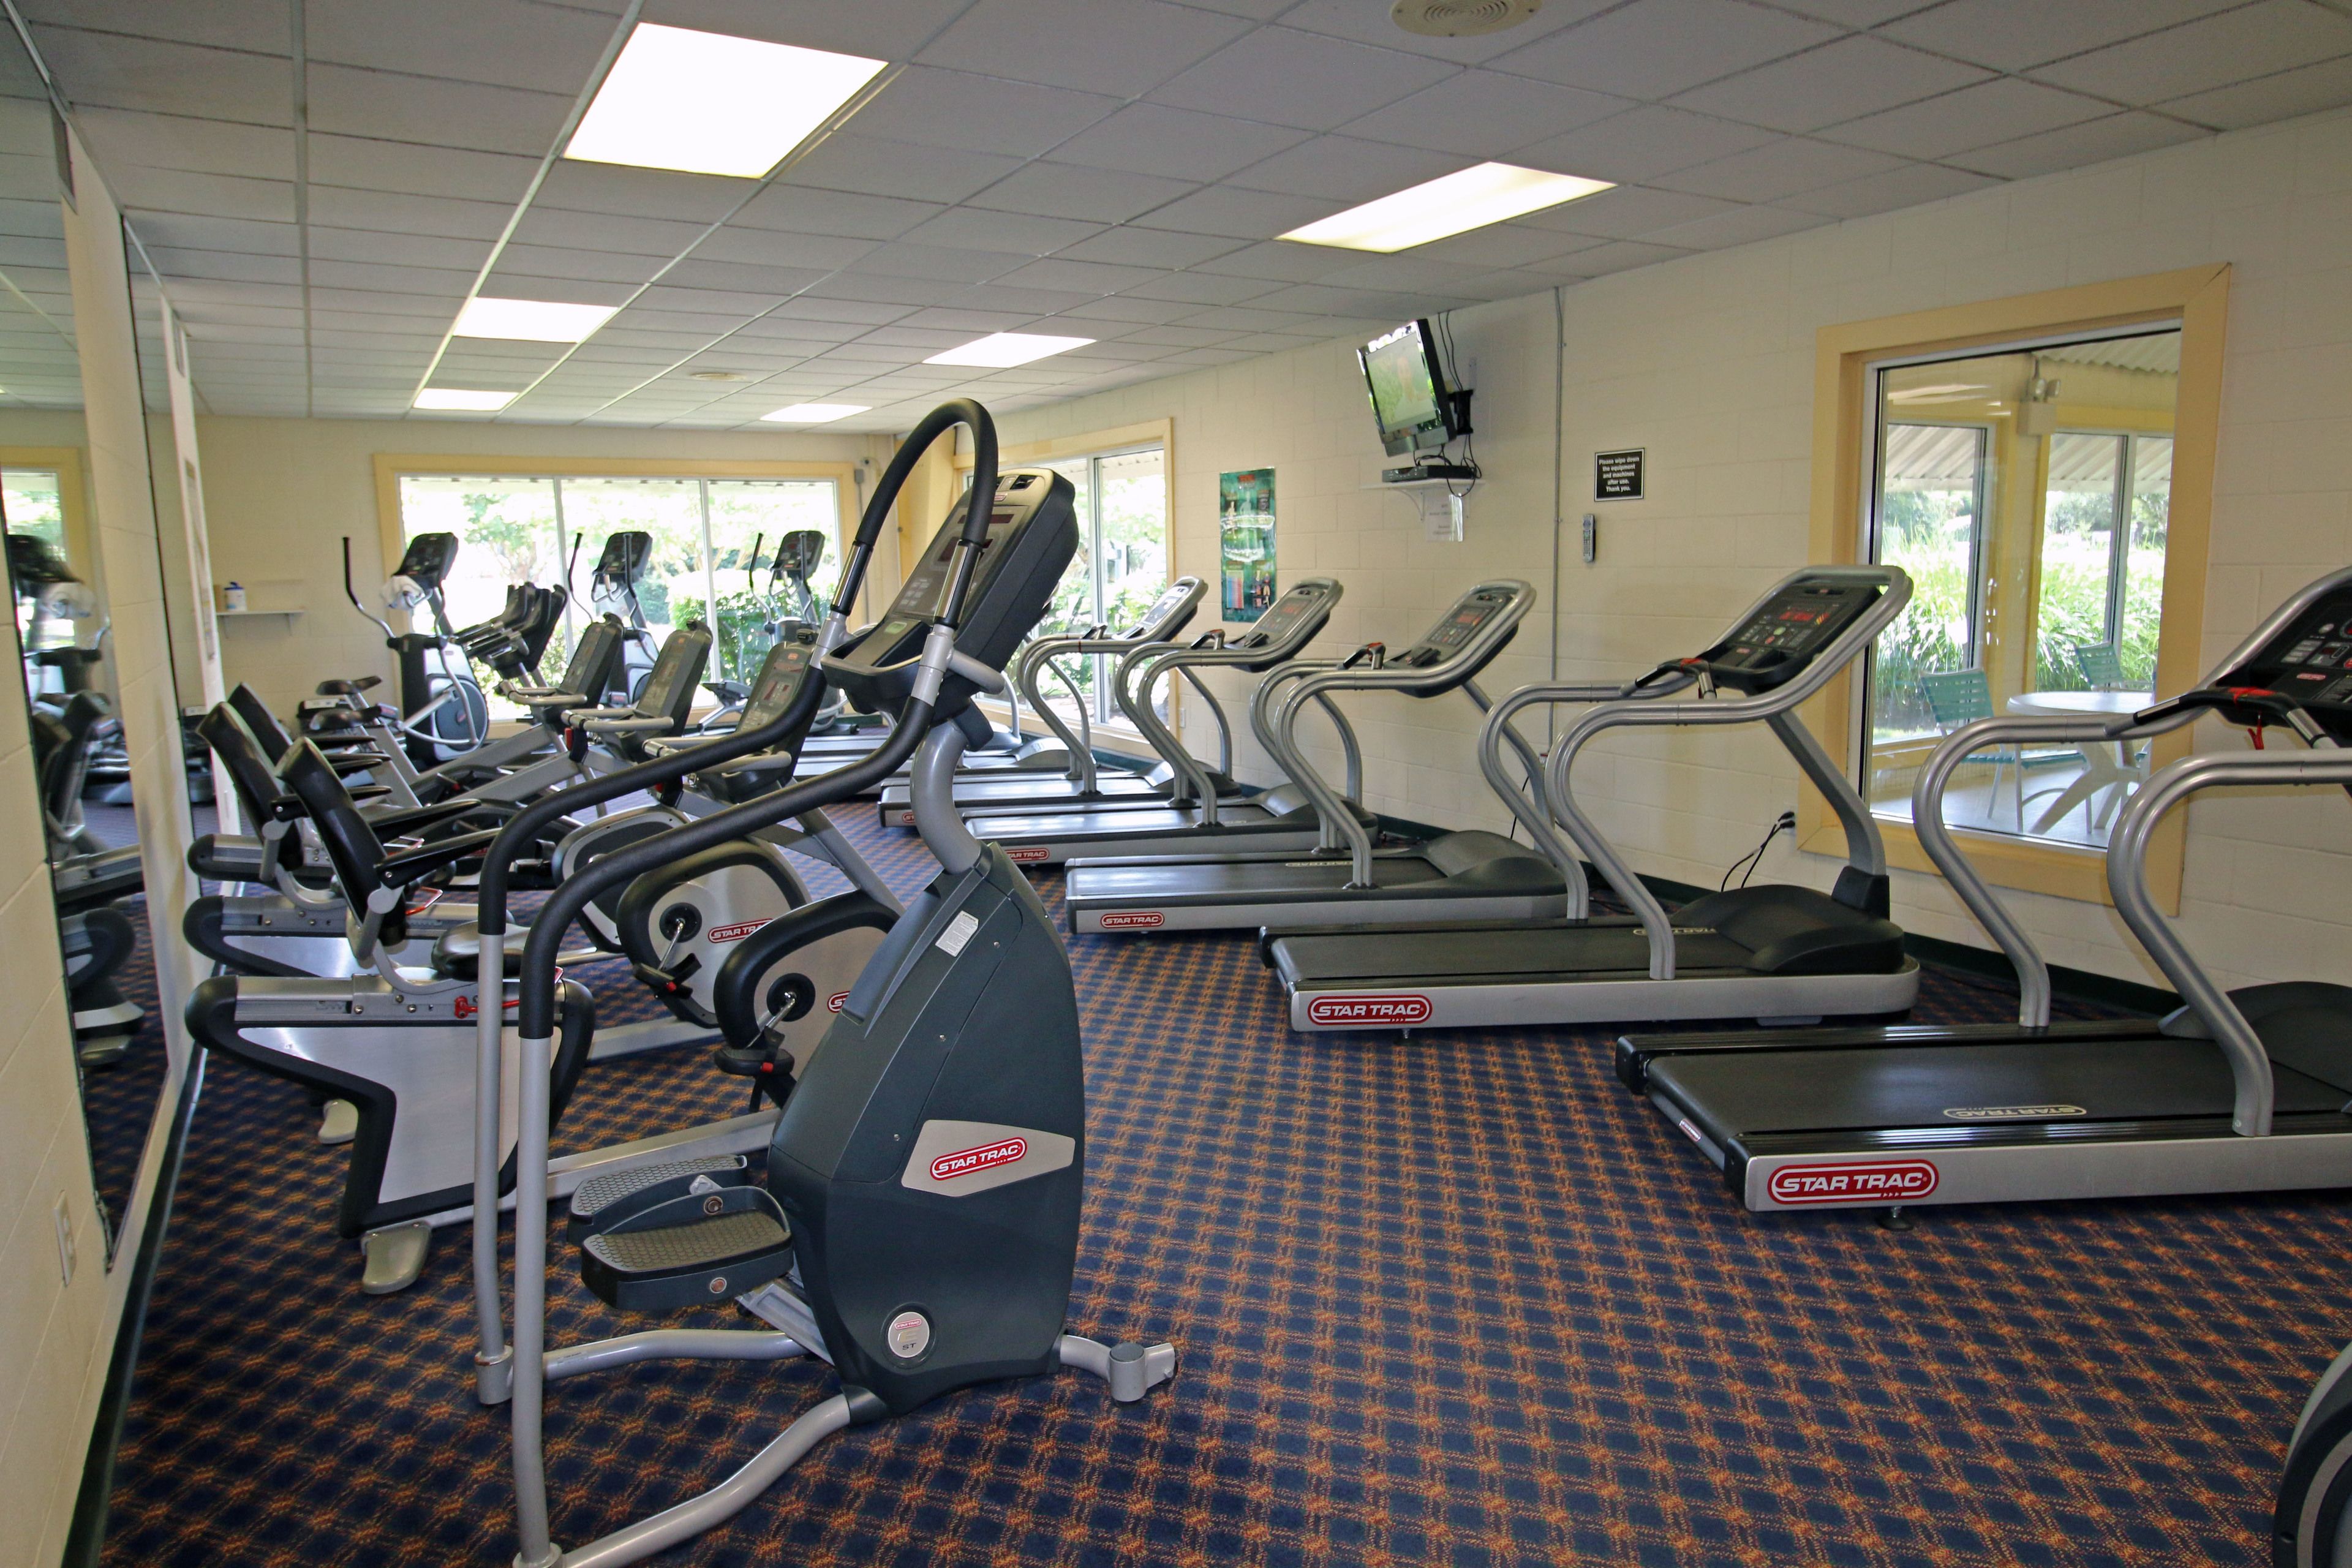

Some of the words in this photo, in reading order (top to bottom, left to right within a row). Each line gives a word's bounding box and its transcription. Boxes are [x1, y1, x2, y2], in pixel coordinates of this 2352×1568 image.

[714, 929, 741, 938] STAR
[742, 925, 761, 933] TR
[1317, 1005, 1366, 1016] STAR
[1370, 1004, 1421, 1016] TRAC
[937, 1155, 978, 1172] STAR
[979, 1145, 1019, 1162] TRAC
[1781, 1176, 1849, 1193] STAR
[1853, 1172, 1923, 1189] TRAC
